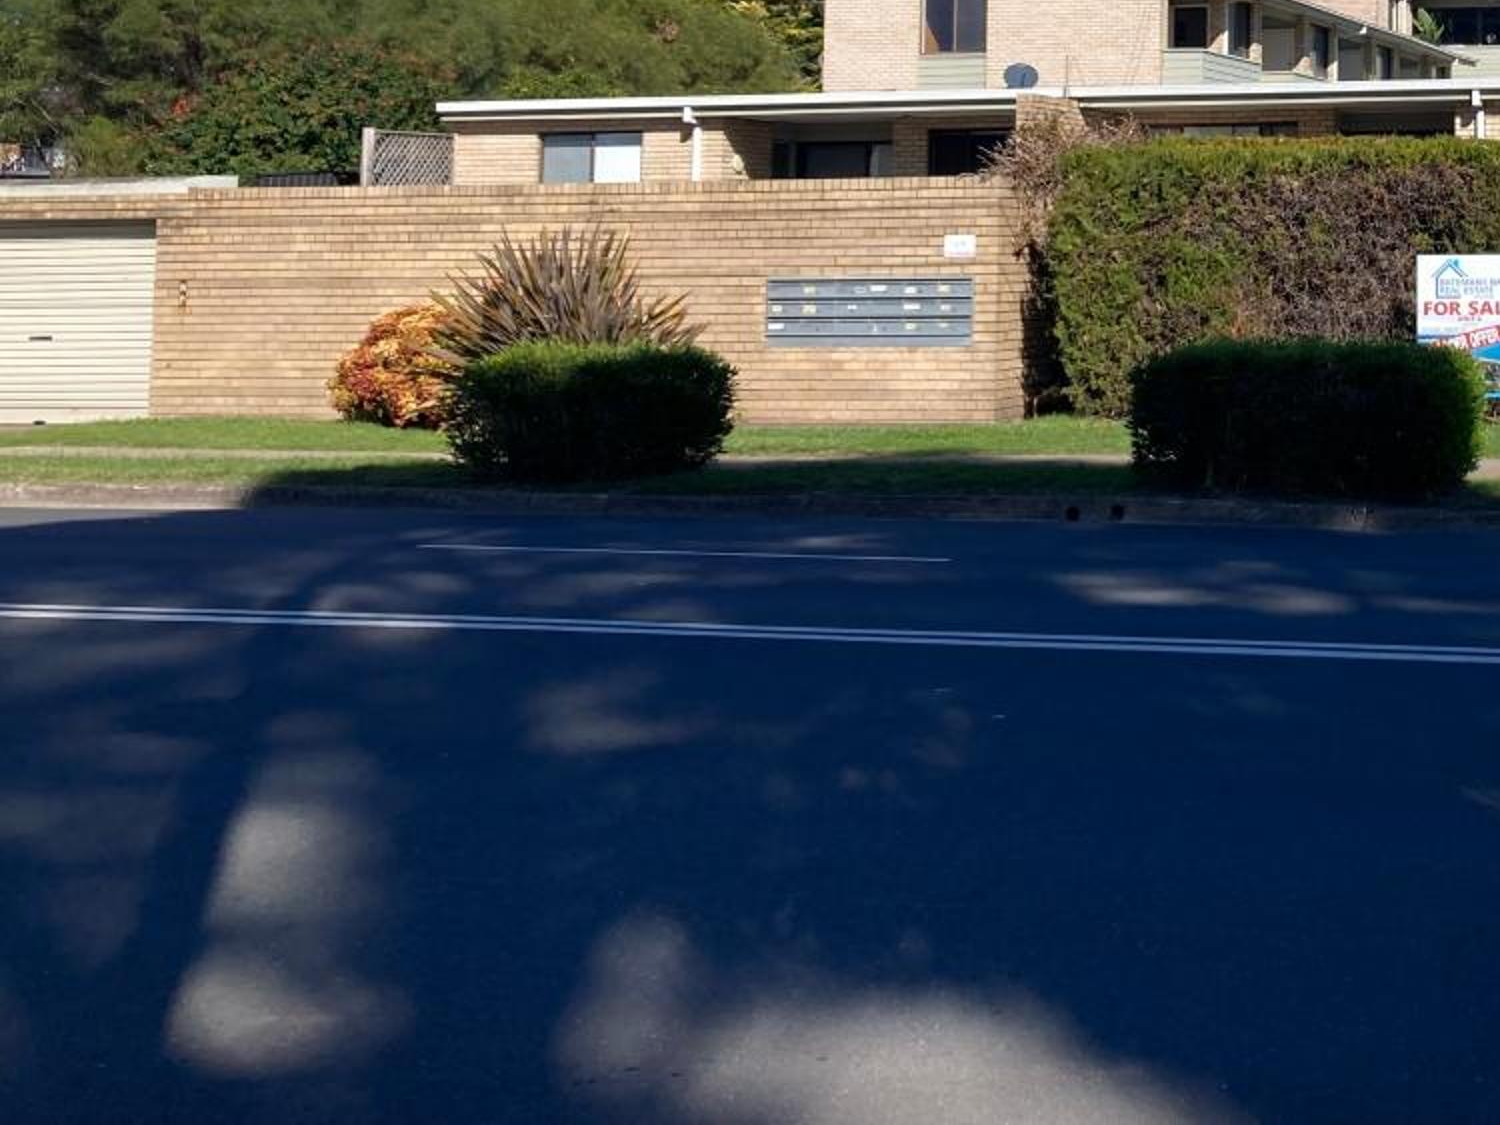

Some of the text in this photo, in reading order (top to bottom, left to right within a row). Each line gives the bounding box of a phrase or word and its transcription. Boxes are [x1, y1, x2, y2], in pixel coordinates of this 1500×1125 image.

[1463, 286, 1493, 295] ESTATE
[1423, 300, 1461, 316] FOR
[1470, 328, 1500, 348] OFFER
